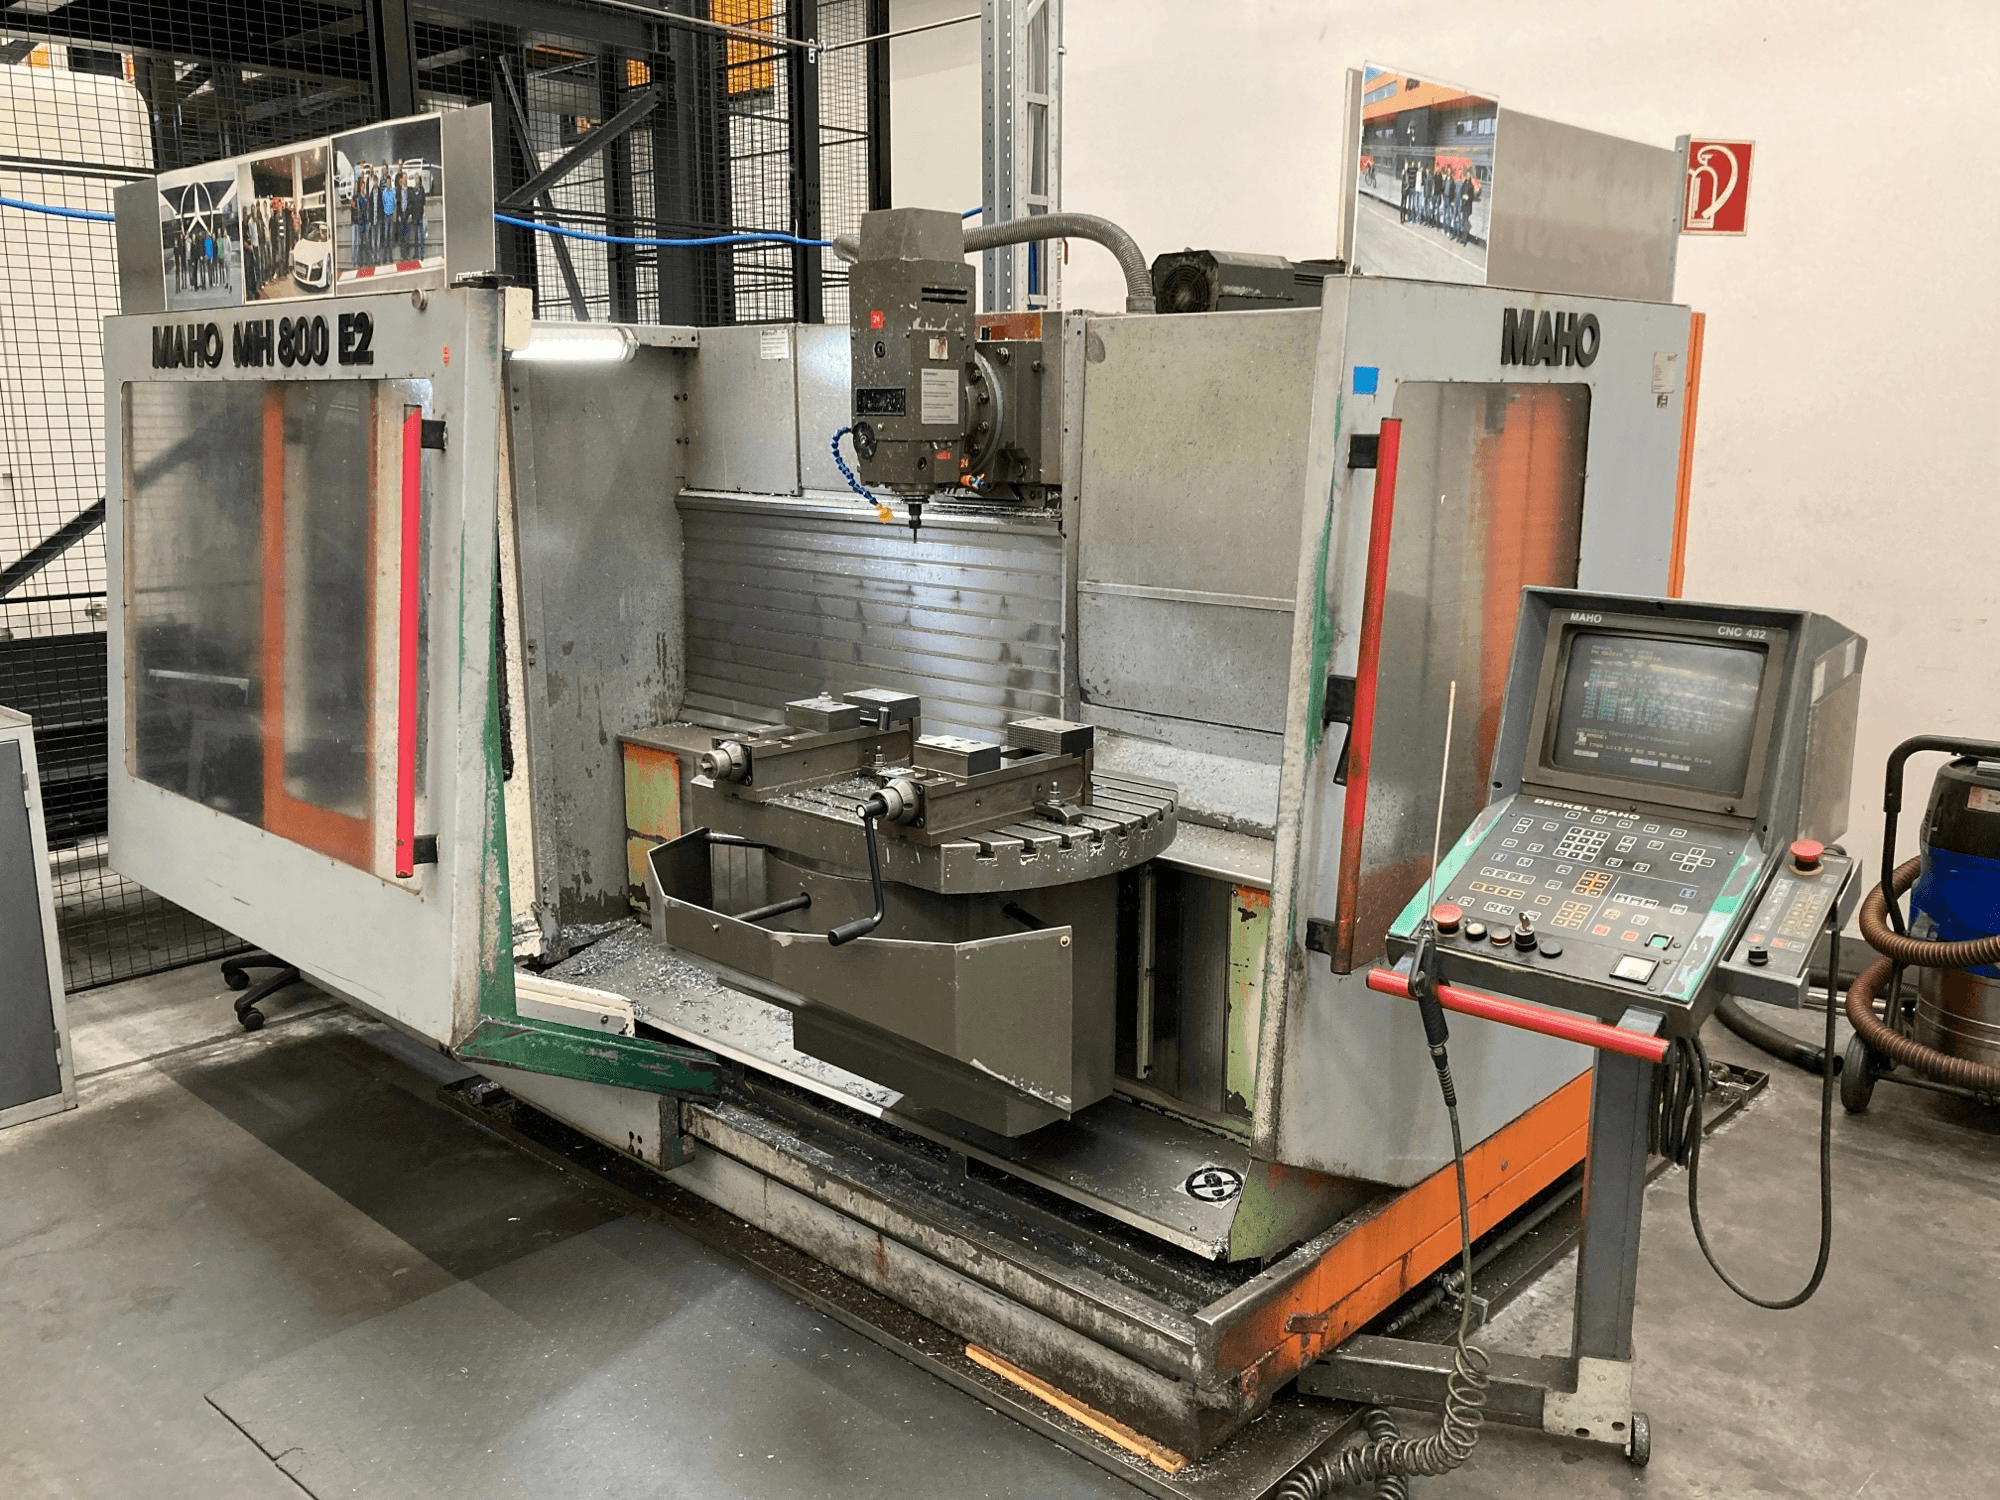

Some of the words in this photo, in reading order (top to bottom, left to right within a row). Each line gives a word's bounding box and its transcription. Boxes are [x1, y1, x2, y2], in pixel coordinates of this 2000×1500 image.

[152, 322, 224, 368] MAHO
[233, 318, 274, 366] MH
[278, 316, 329, 366] 800
[338, 311, 374, 365] E2
[1501, 308, 1600, 368] MAHO
[1570, 612, 1602, 623] MAHO
[1717, 626, 1742, 637] CNC
[1746, 629, 1766, 639] 432
[1534, 798, 1591, 812] DECKEL
[1595, 808, 1640, 820] MAHO
